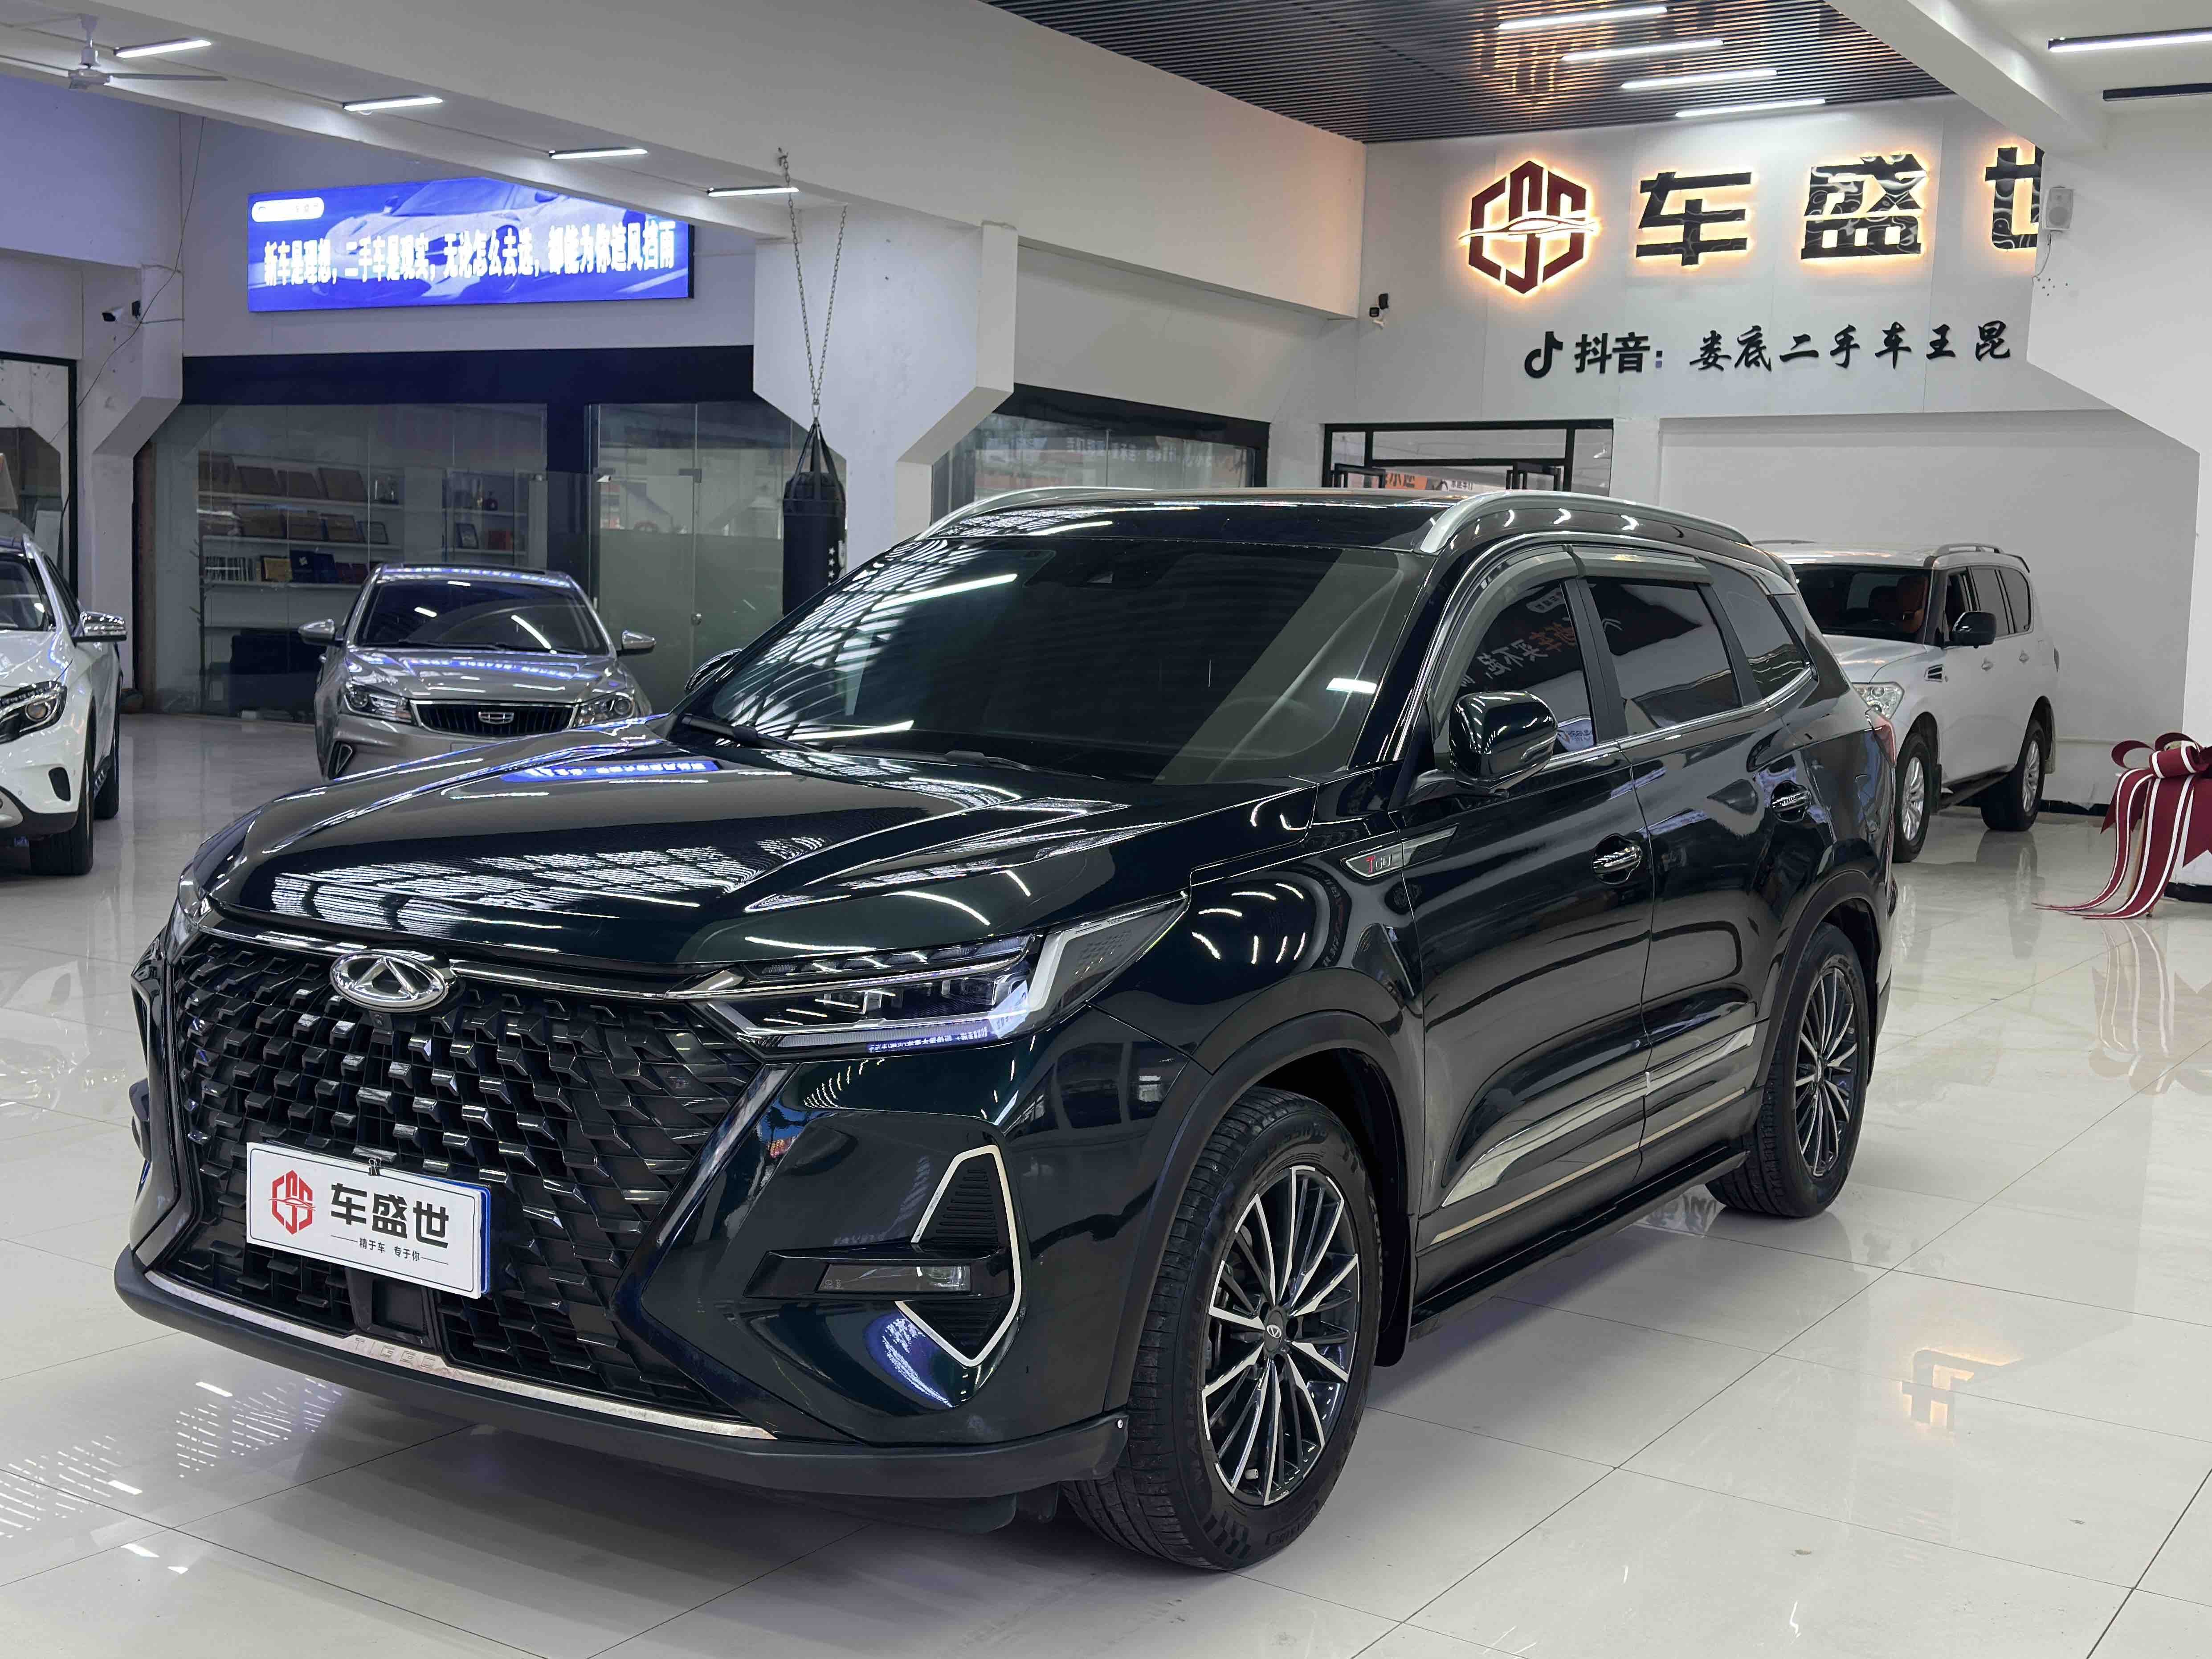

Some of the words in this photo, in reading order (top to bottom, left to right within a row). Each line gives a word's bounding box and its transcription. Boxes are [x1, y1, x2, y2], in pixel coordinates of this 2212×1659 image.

[331, 1183, 449, 1249] 车盛世
[359, 1238, 385, 1253] 精于车
[394, 1246, 420, 1262] 专于你
